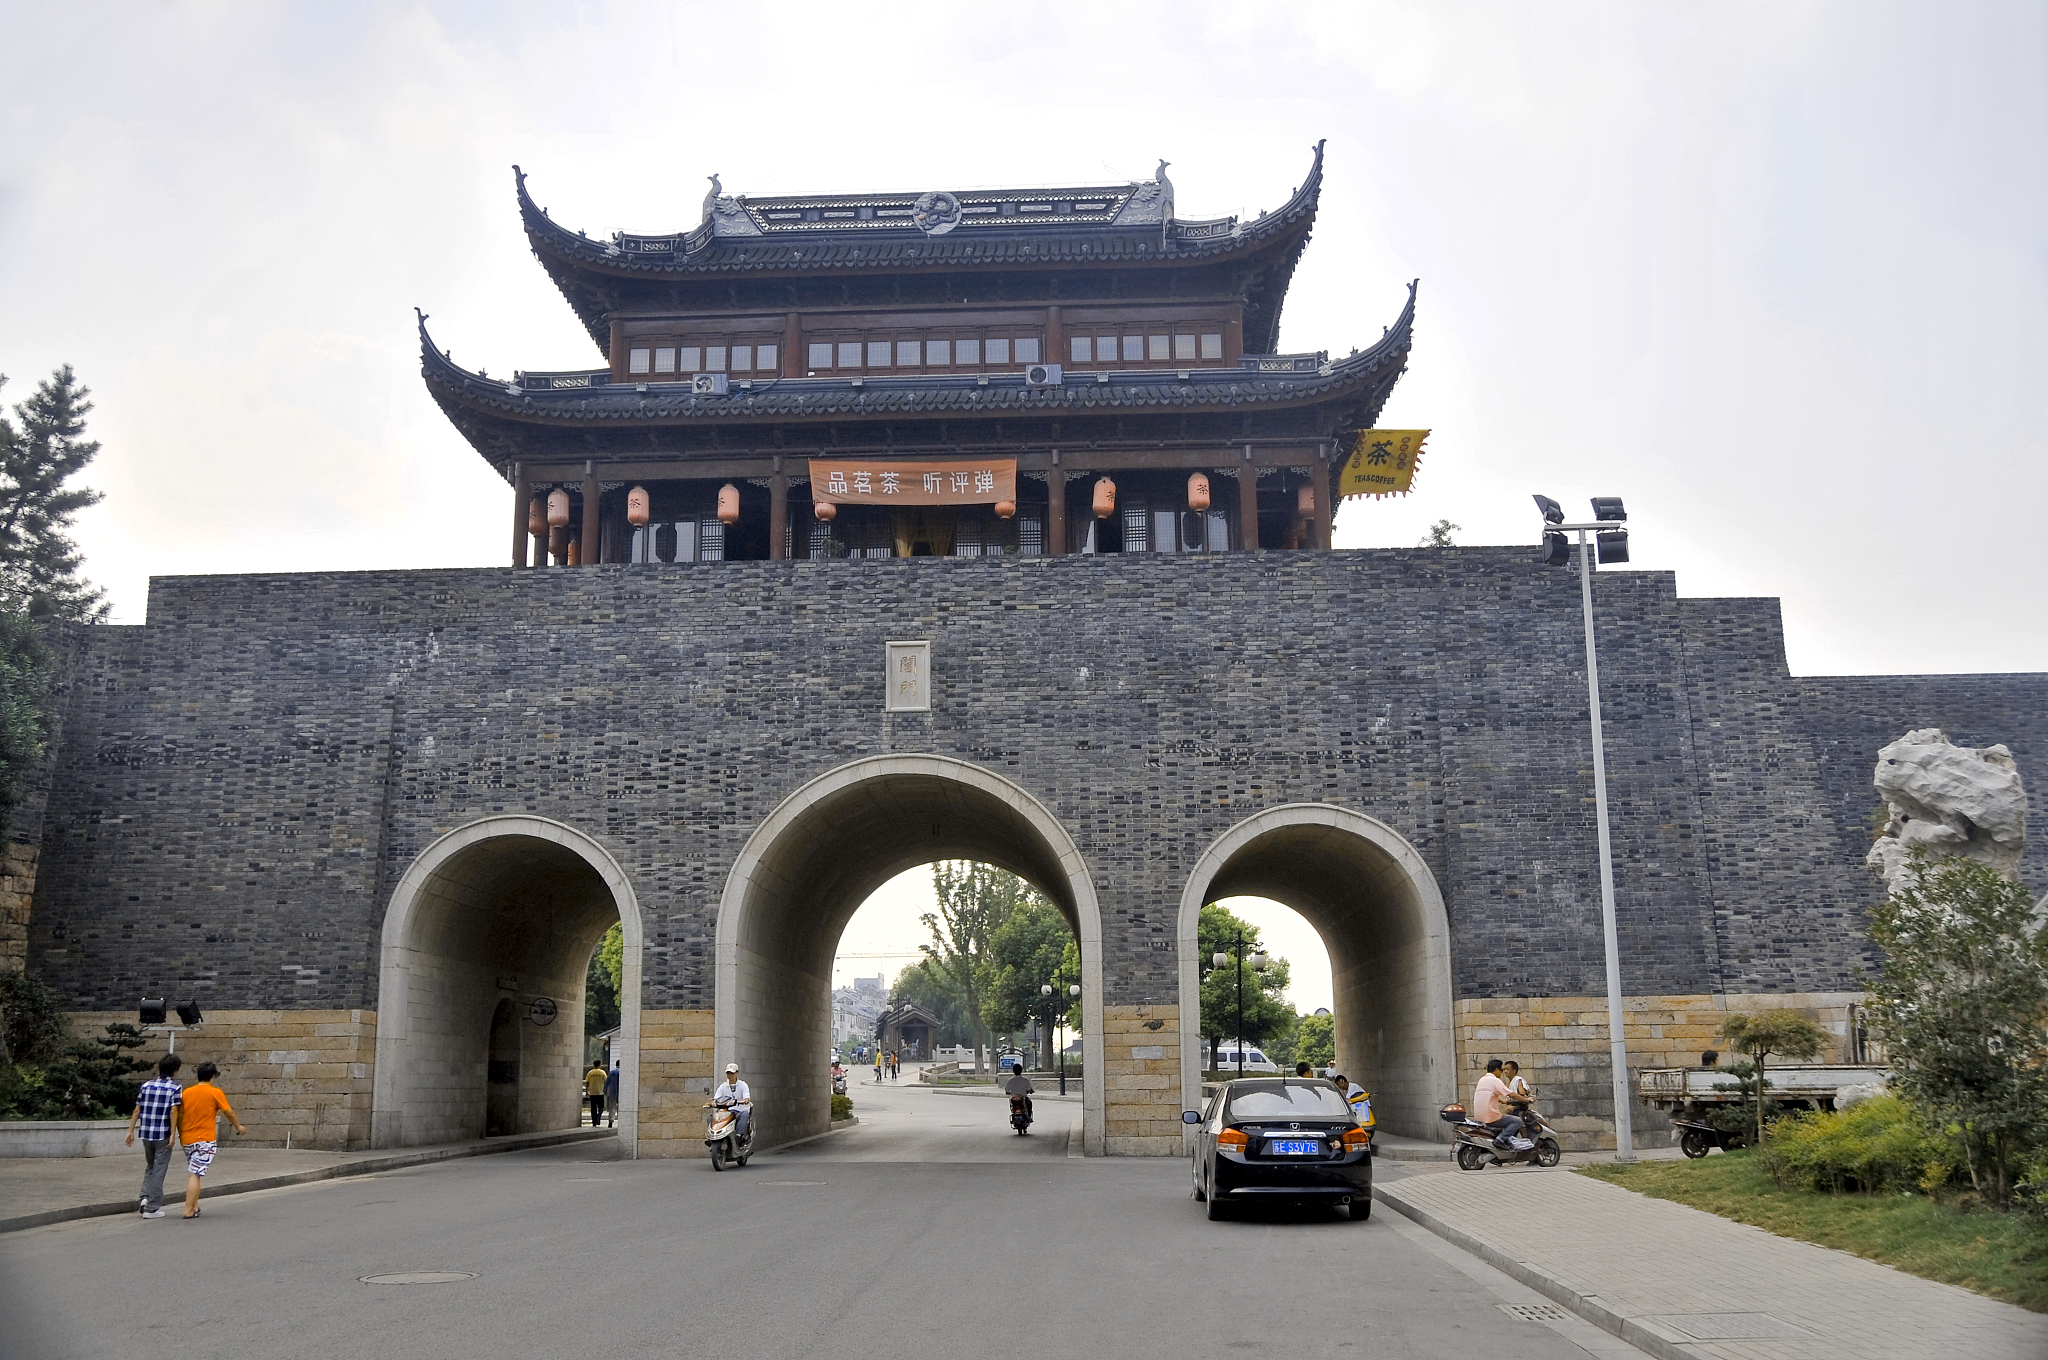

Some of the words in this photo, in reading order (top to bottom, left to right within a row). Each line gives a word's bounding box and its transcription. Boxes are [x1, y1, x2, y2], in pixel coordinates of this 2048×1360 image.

[1367, 440, 1393, 466] 茶
[828, 470, 901, 494] 品茗茶
[923, 470, 994, 495] 听评弹
[1355, 474, 1396, 485] TEA&COFFEE
[1196, 483, 1209, 496] 茶
[628, 498, 641, 510] 茶
